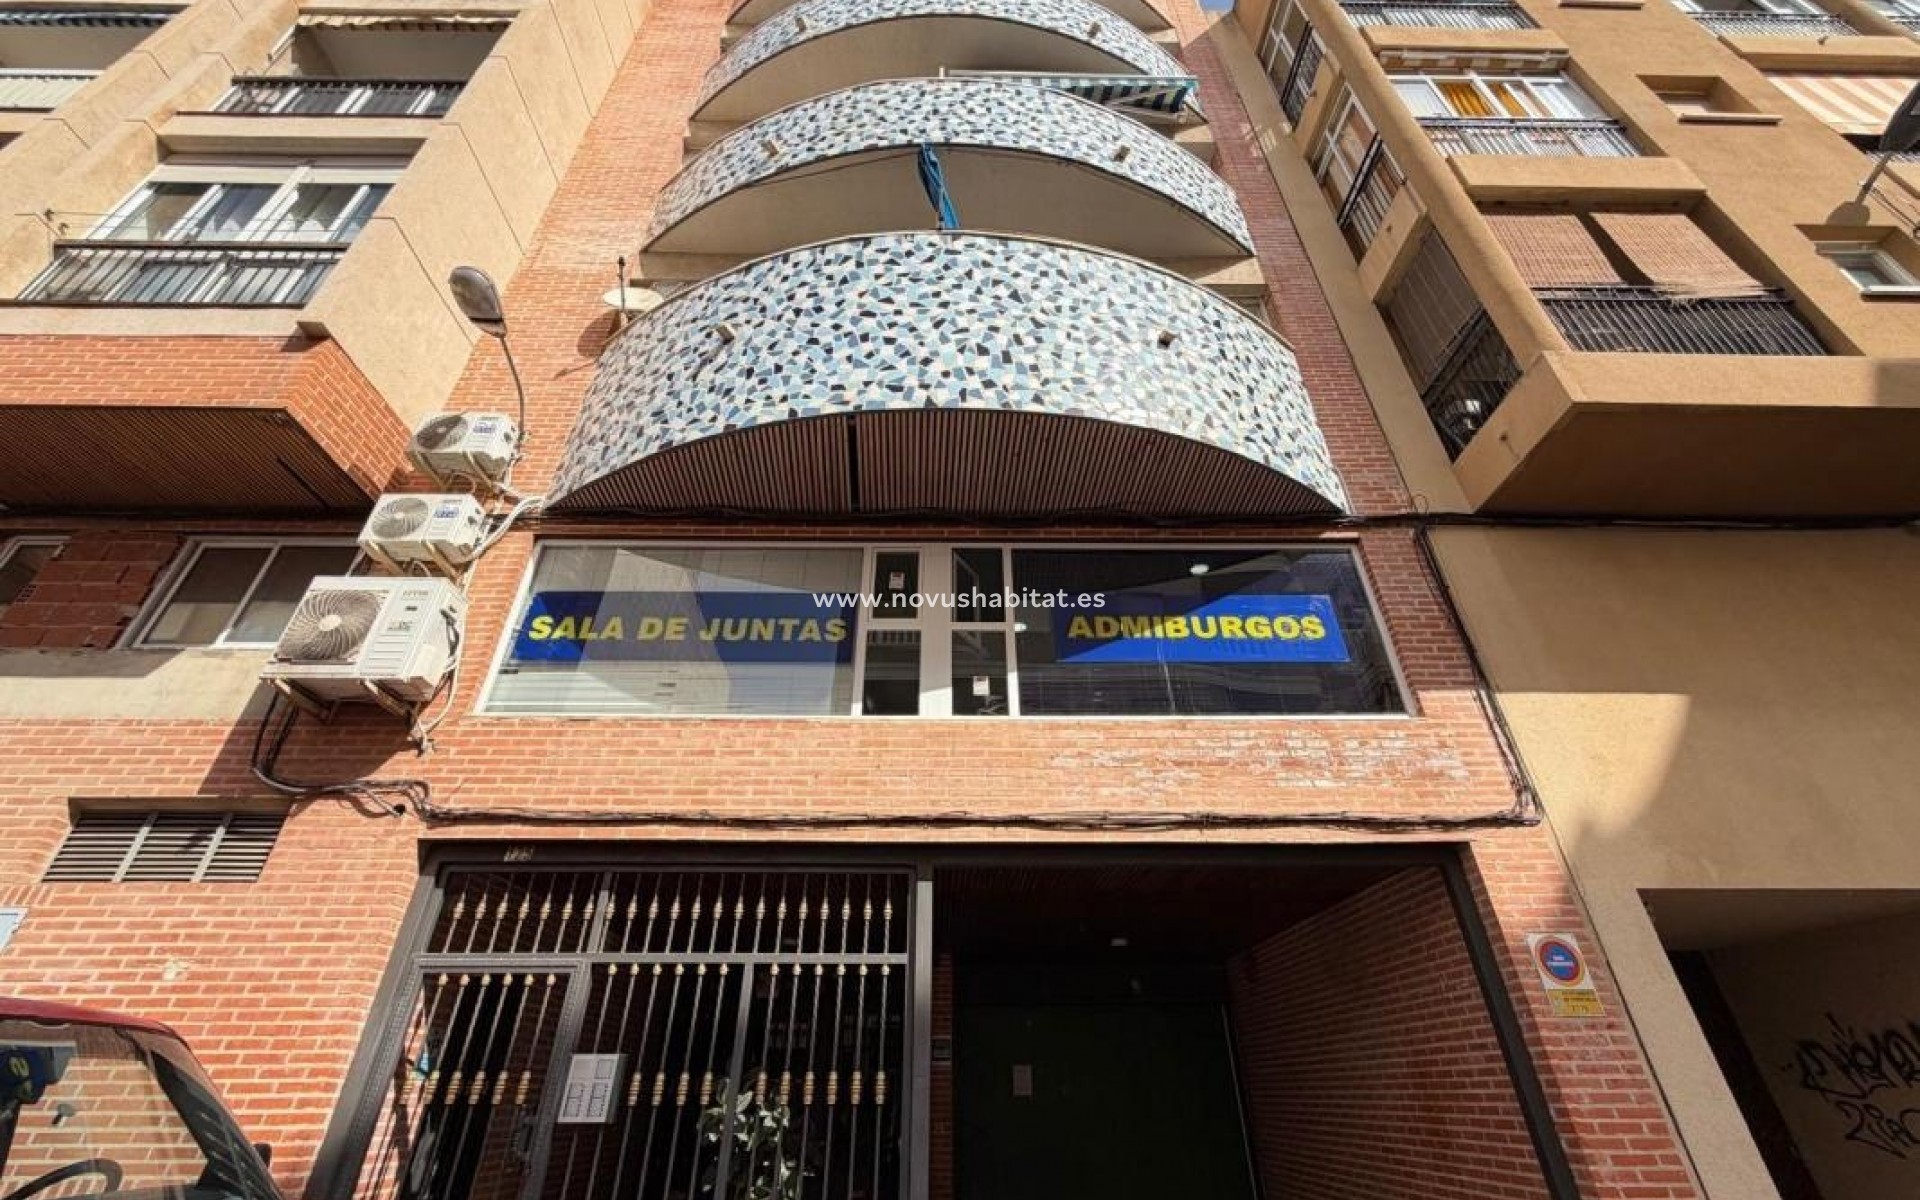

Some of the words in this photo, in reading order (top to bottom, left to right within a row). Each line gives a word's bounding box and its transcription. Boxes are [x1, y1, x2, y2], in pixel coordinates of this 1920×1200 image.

[527, 616, 622, 641] SALA
[638, 617, 689, 641] DE
[701, 618, 848, 642] JUNTAS
[1068, 615, 1326, 640] ADMIBURGOS
